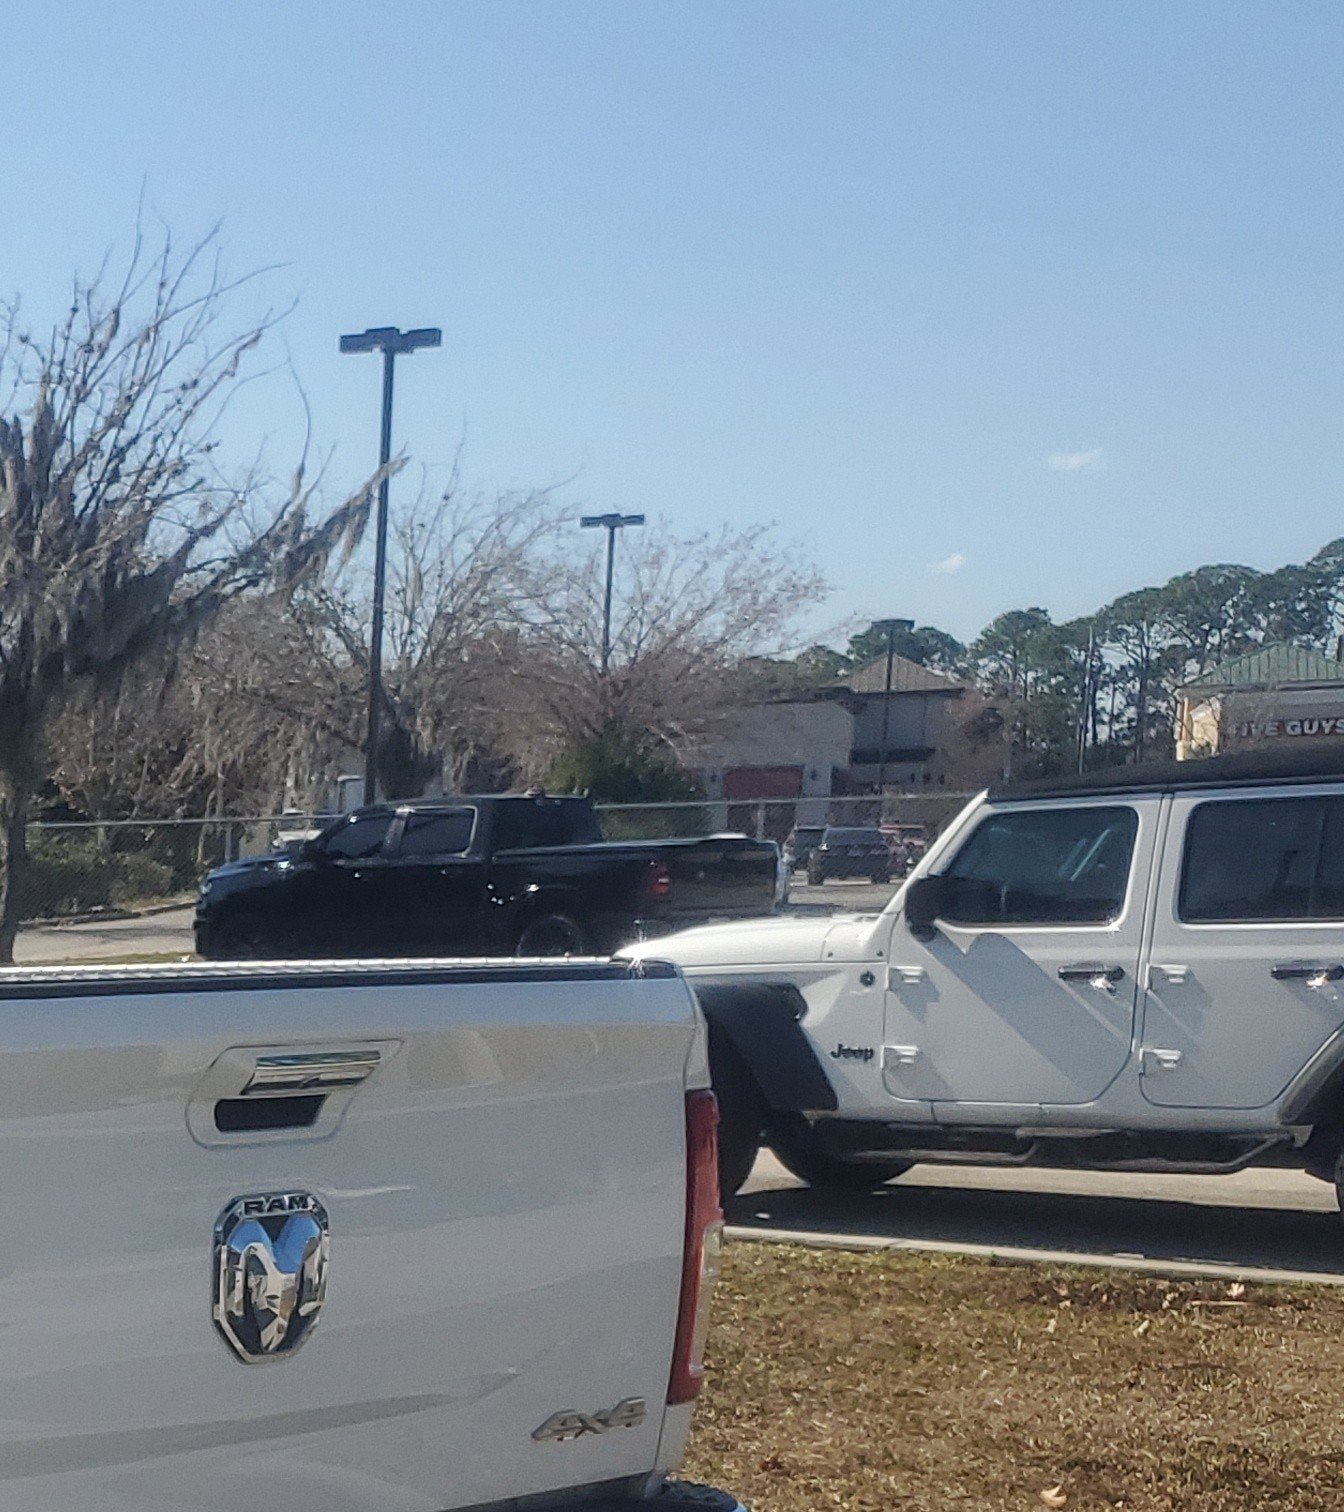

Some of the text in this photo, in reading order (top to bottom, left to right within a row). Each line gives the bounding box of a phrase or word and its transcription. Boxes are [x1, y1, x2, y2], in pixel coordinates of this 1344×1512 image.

[1285, 718, 1344, 736] GUYS
[830, 1043, 874, 1063] Jeep
[240, 1195, 314, 1216] RAM
